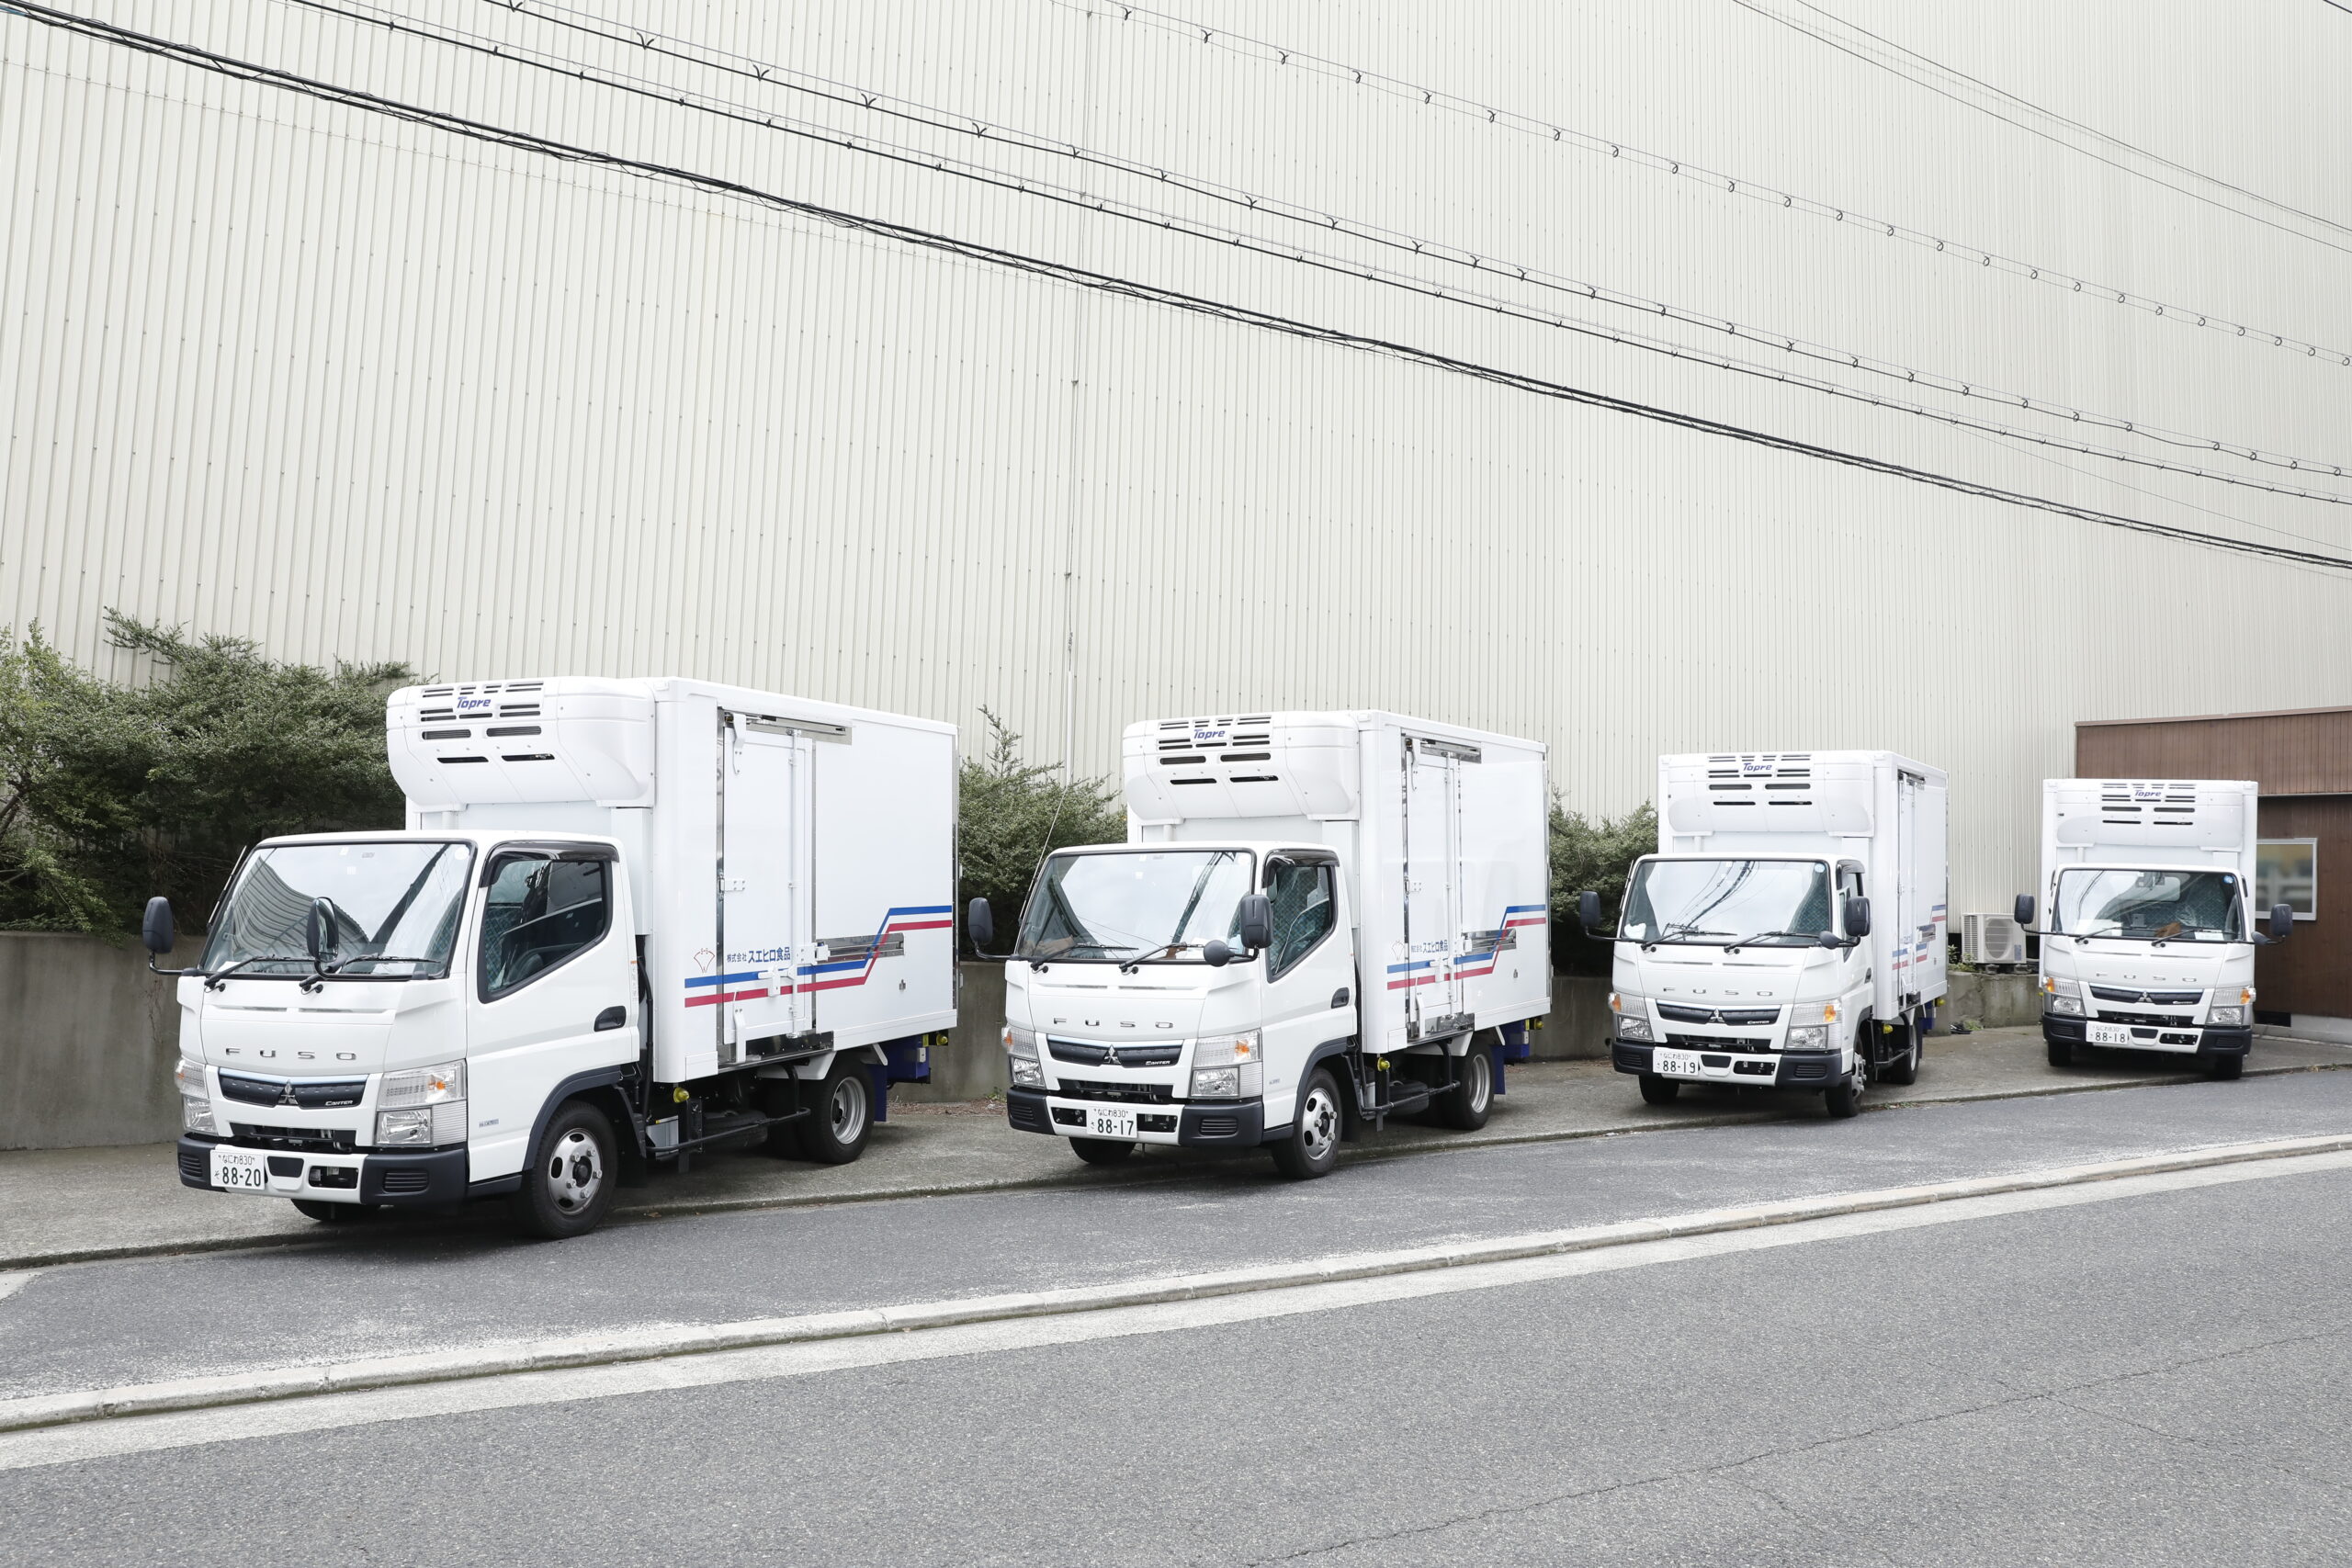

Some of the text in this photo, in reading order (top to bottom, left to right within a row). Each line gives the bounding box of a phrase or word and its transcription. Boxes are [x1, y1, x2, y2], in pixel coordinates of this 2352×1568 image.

[457, 696, 492, 710] Topre
[1193, 728, 1226, 740] Topre
[1743, 762, 1772, 773] Topre
[2134, 789, 2162, 798] Topre
[1663, 987, 1773, 997] FUSO
[1053, 1018, 1174, 1029] FUSO
[2096, 1032, 2125, 1043] 88-18
[225, 1047, 356, 1061] FUSO
[1663, 1060, 1696, 1074] 88-19
[1097, 1118, 1135, 1136] 88-17
[222, 1155, 253, 1166] なにわ830
[222, 1166, 262, 1187] 88-20
